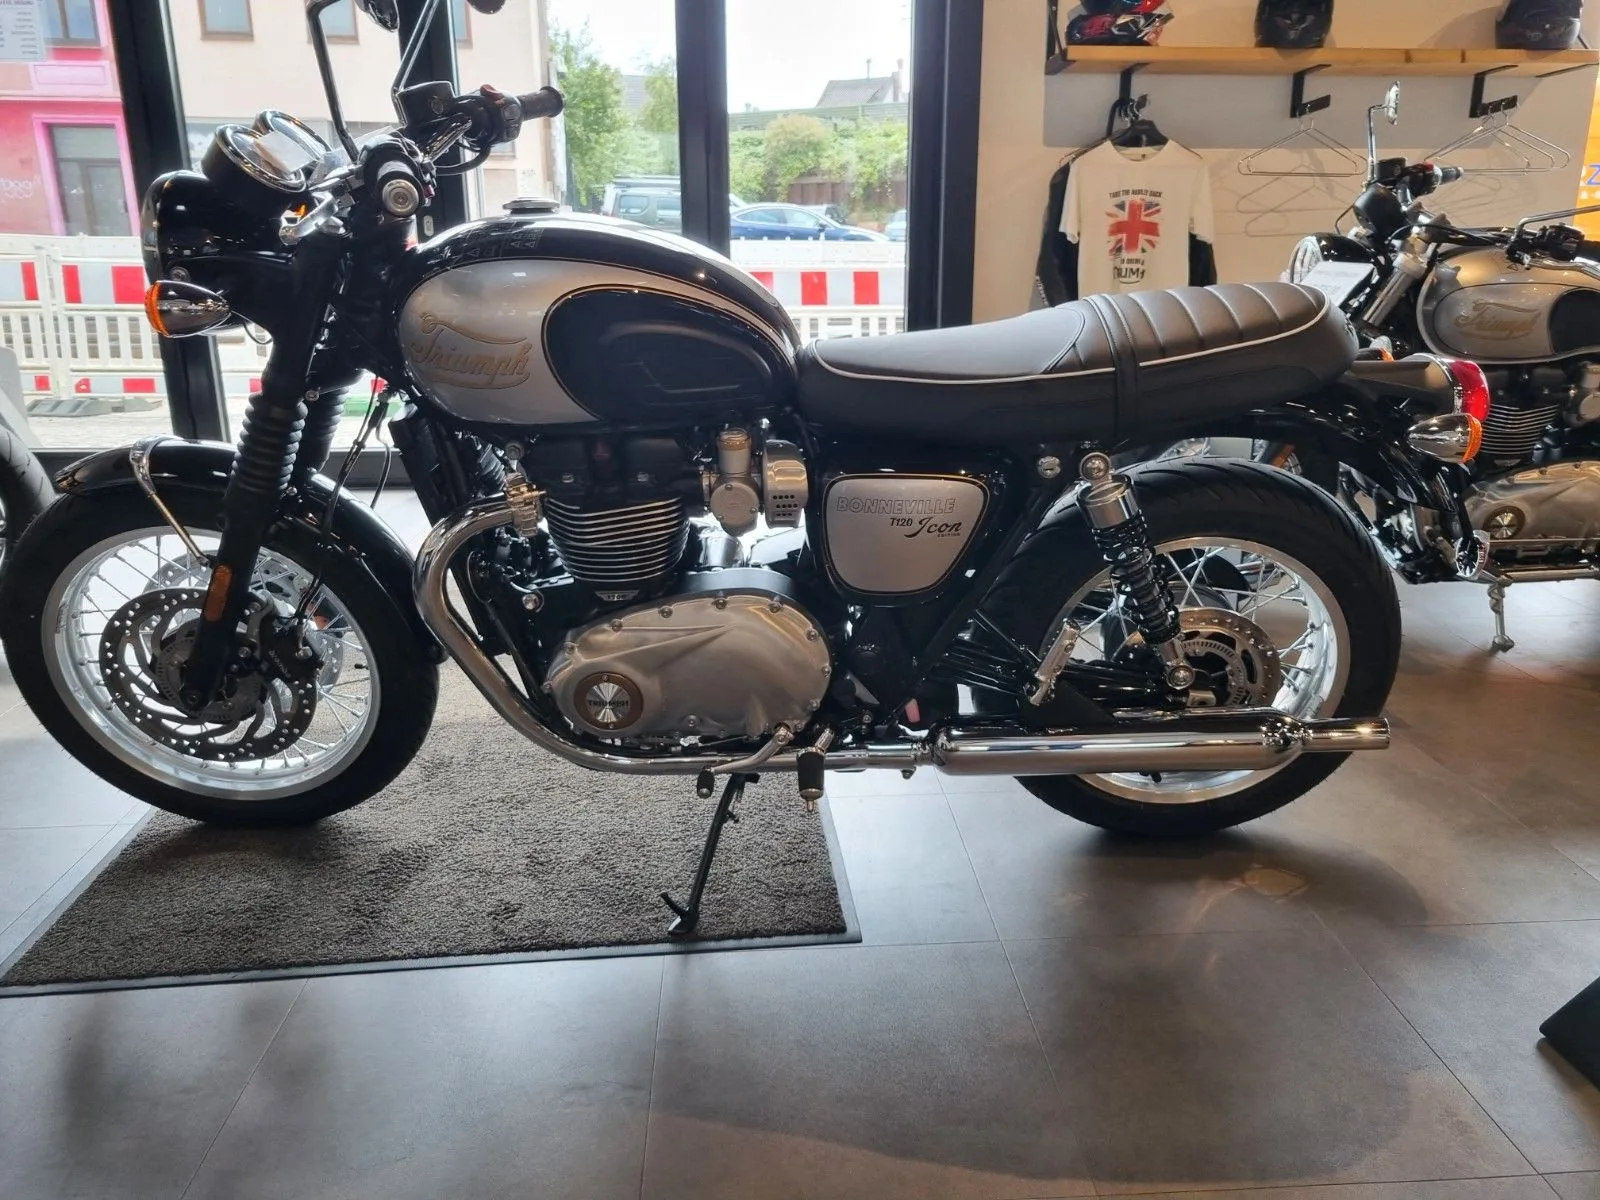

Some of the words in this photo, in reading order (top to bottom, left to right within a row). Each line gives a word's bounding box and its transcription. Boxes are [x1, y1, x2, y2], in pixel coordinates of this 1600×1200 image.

[409, 312, 533, 390] Triumph
[837, 496, 956, 515] BONNEVILLE
[890, 517, 913, 527] T120
[904, 517, 962, 539] Icon
